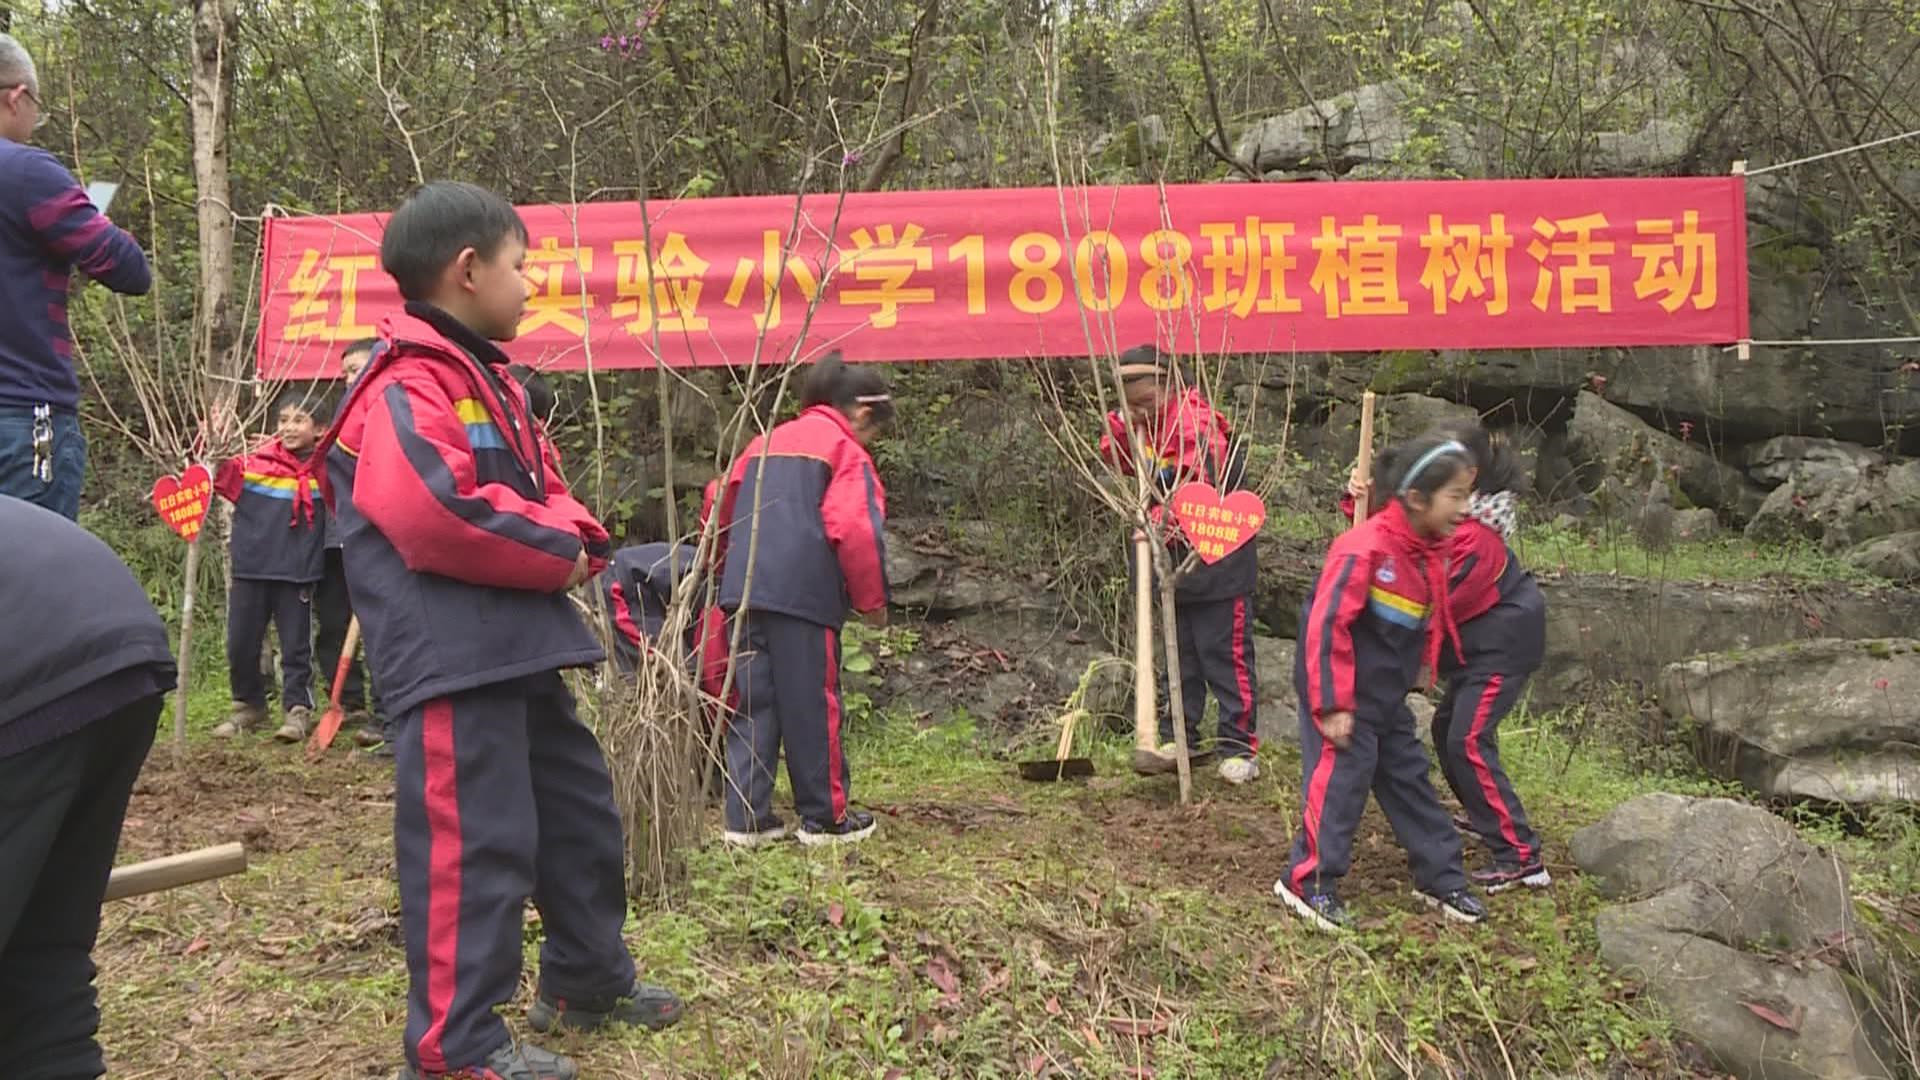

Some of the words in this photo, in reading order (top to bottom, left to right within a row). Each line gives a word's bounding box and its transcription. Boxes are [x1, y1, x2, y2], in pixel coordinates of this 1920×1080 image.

[283, 209, 1718, 343] 红实验小学1808班植树活动
[1181, 501, 1260, 529] 红日实验小学
[1189, 520, 1239, 543] 1808班
